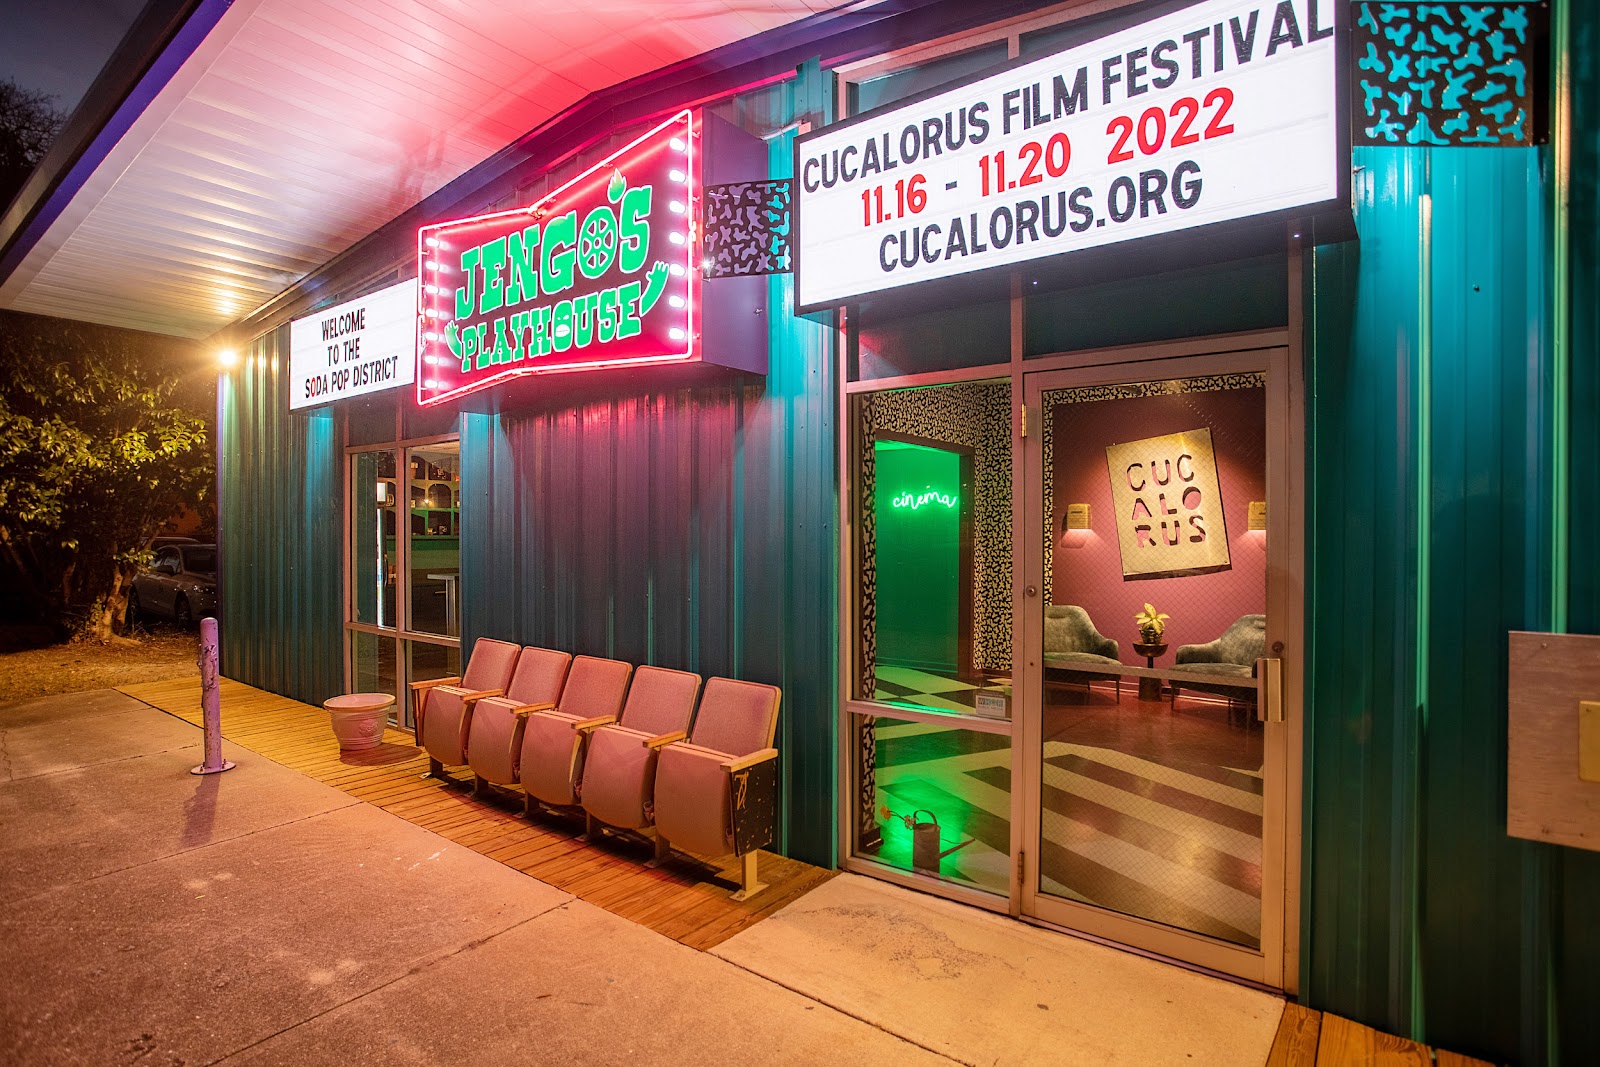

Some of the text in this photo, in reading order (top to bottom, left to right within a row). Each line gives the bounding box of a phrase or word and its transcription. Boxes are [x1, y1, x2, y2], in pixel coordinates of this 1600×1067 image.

[803, 0, 1334, 193] CUCALORUS FILM FESTIVAL
[861, 174, 927, 227] 11.16
[979, 132, 1071, 197] 11.20
[1106, 87, 1235, 165] 2022
[879, 160, 1203, 272] CUCALORUS.ORG
[321, 308, 366, 341] WELCOME
[461, 280, 642, 373] PLAYHOUSE
[328, 337, 360, 366] TO THE
[305, 355, 398, 399] SODA POP DISTRICT
[1126, 453, 1195, 492] CUC
[893, 491, 958, 510] cinema
[1131, 486, 1202, 521] ALO
[1134, 514, 1206, 549] RUS
